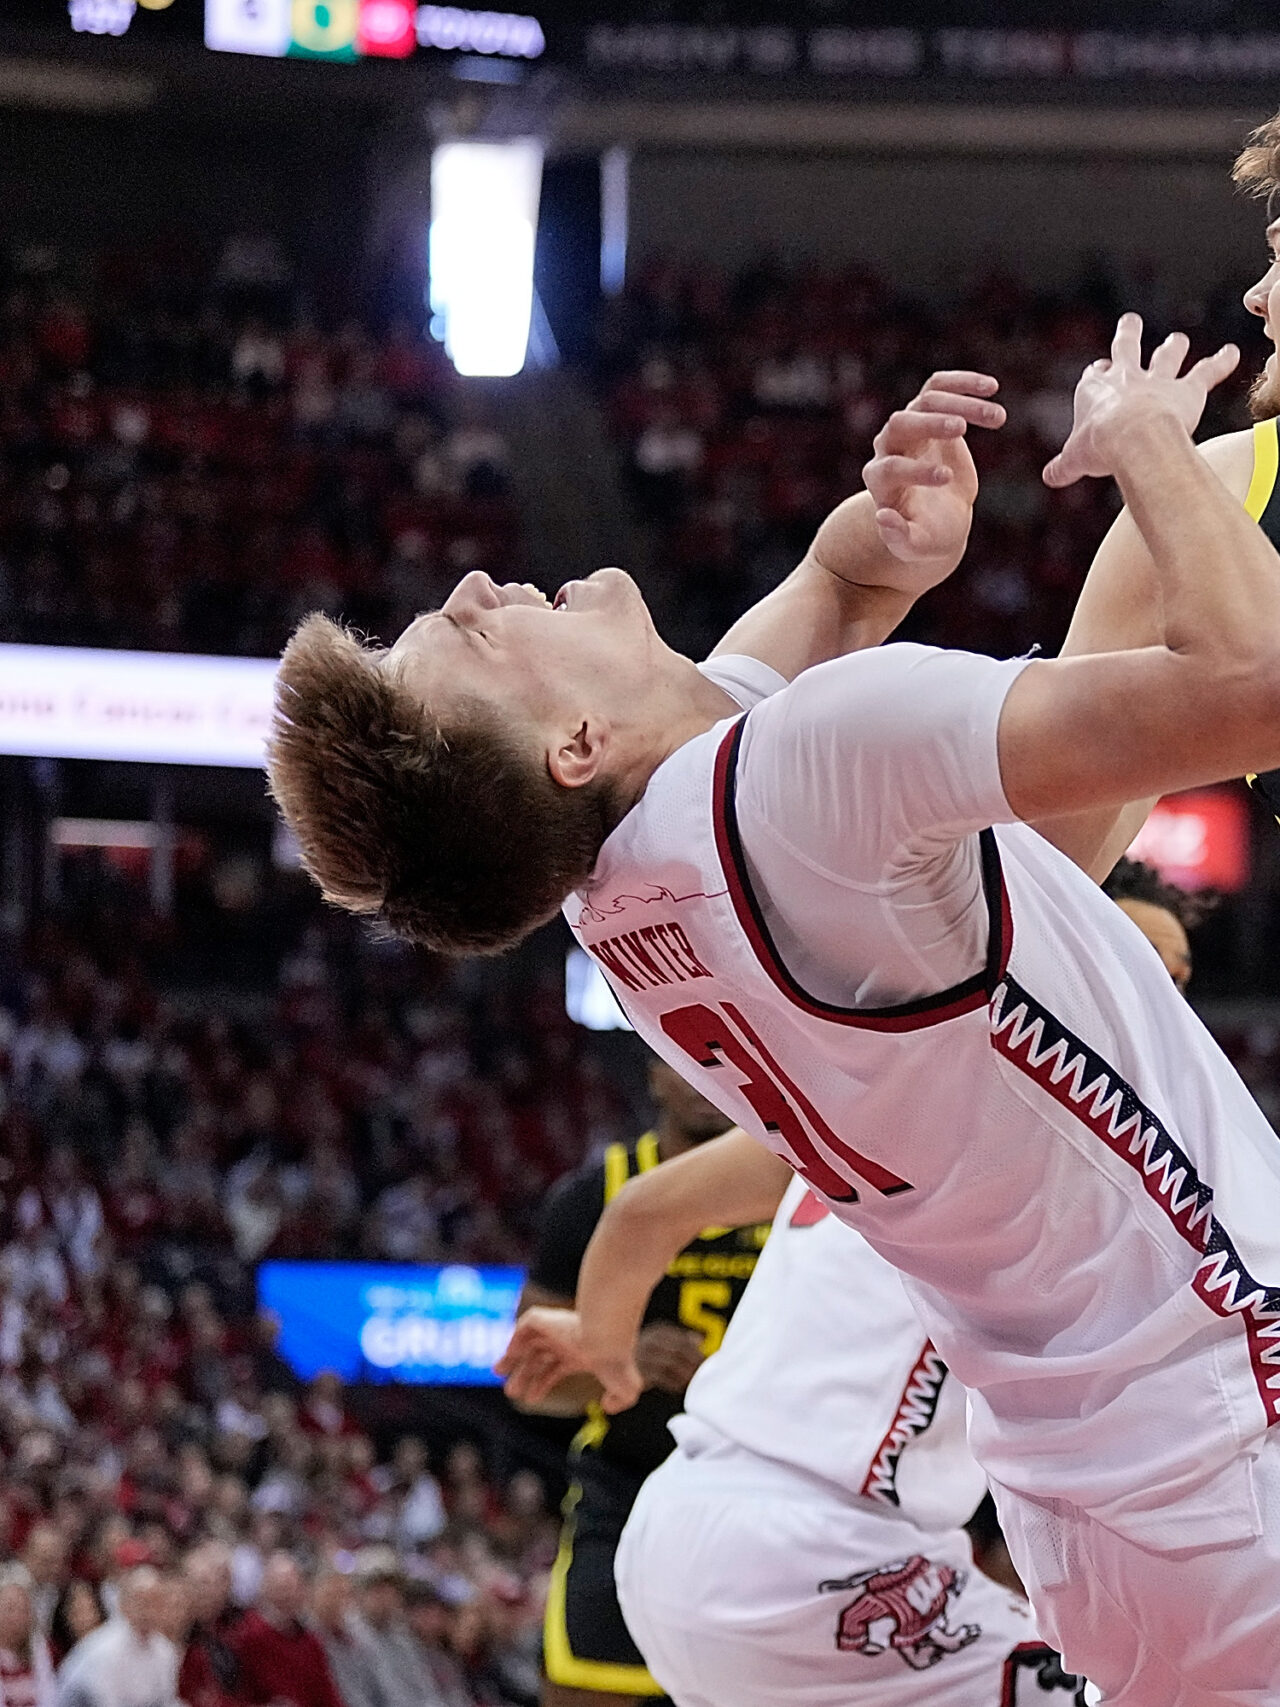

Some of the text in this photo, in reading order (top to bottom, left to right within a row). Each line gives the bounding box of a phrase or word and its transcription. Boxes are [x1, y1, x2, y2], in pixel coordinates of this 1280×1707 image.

[589, 922, 714, 992] WINTER
[660, 1001, 916, 1206] 31
[678, 1281, 732, 1357] 5
